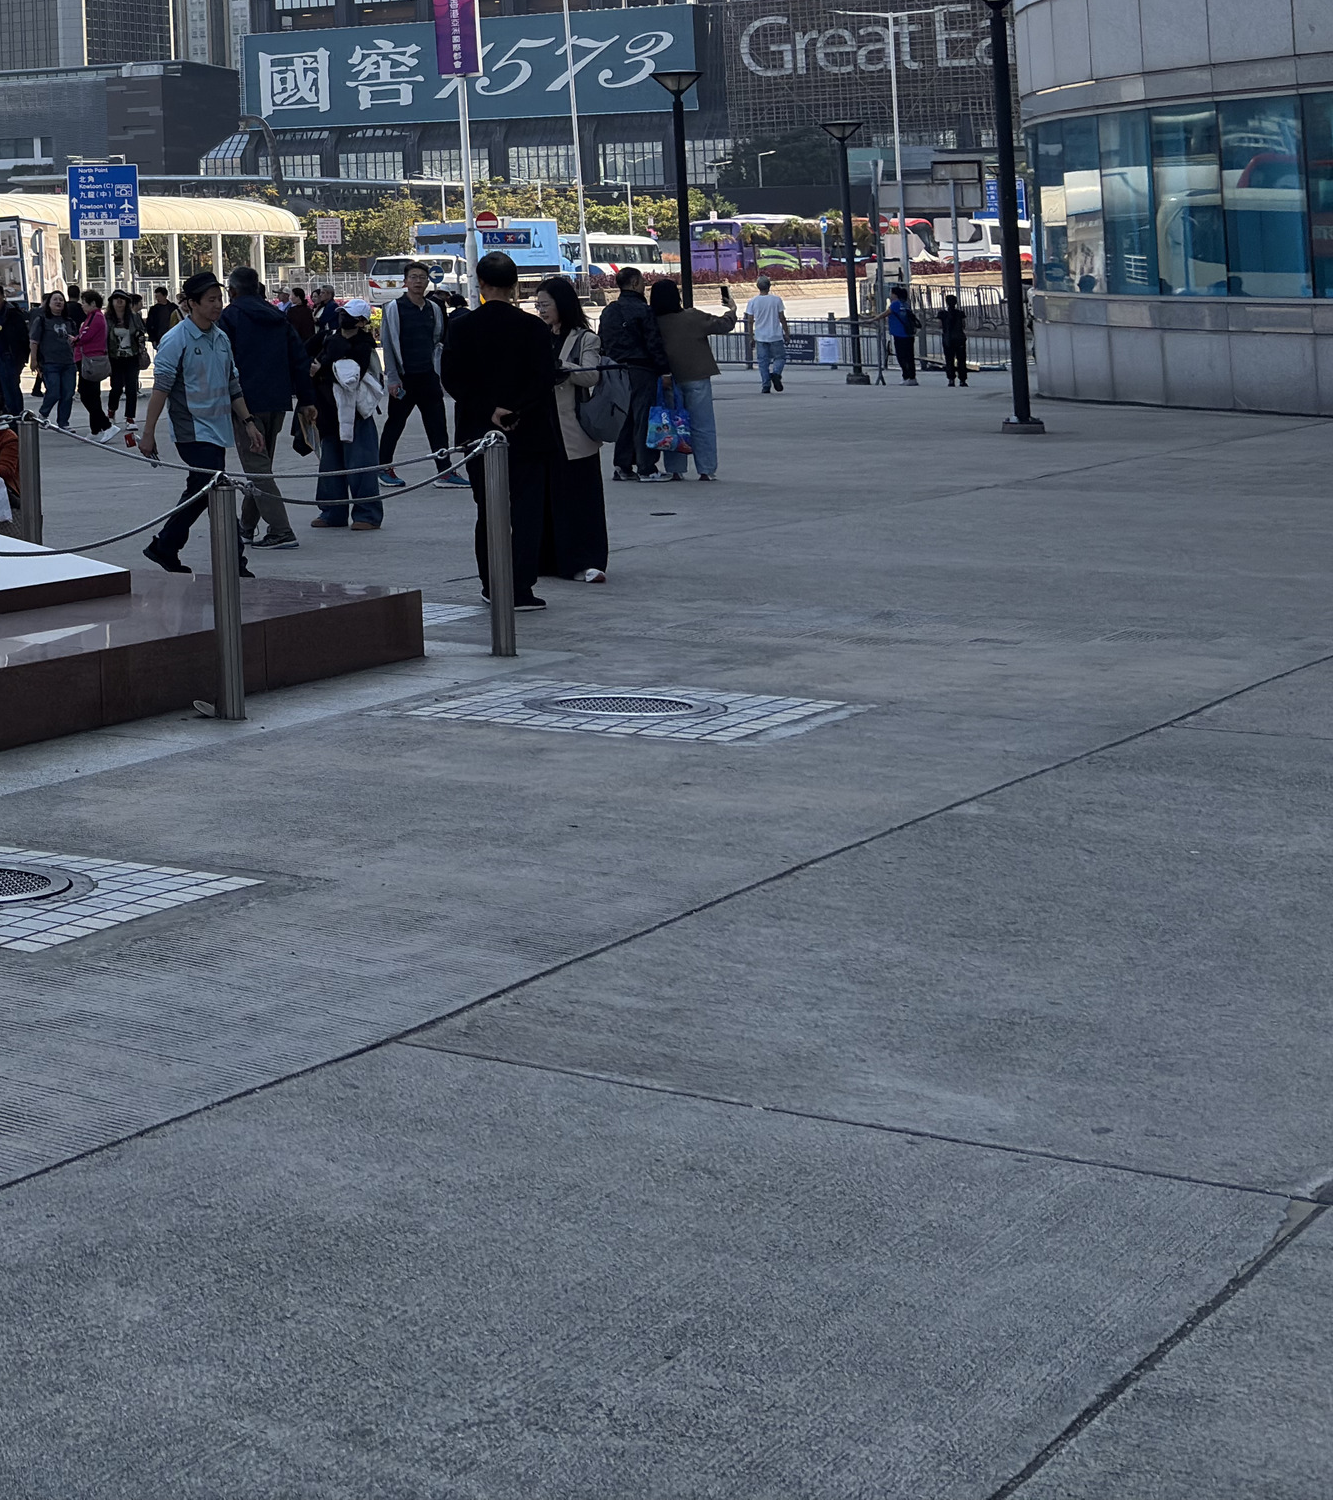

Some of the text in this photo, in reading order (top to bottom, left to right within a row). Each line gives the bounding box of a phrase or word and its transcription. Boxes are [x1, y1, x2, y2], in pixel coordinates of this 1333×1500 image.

[740, 12, 924, 77] Great
[258, 39, 425, 119] 國窖
[79, 175, 95, 183] 北角
